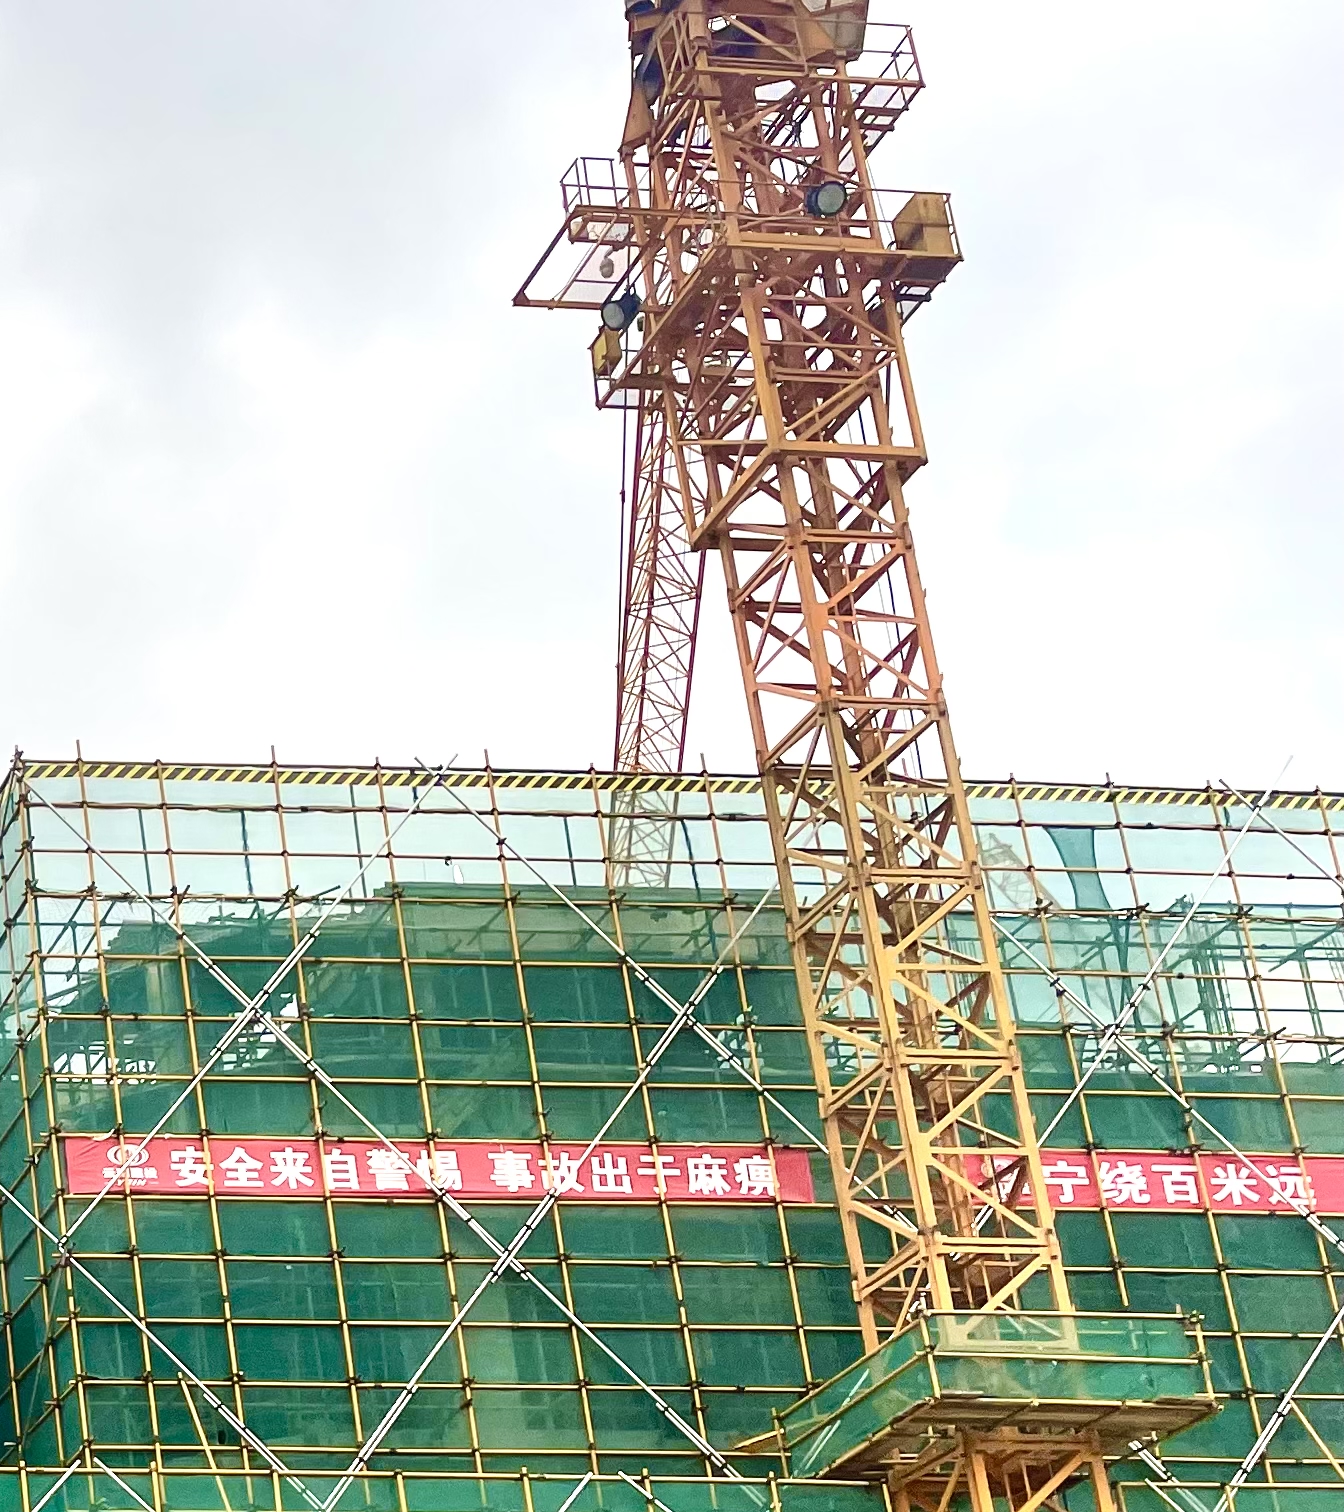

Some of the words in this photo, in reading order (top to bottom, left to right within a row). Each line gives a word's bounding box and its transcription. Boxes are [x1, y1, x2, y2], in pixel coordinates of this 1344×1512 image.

[170, 1146, 463, 1191] 安全来自警惕
[1043, 1160, 1317, 1205] 宁绕百米远
